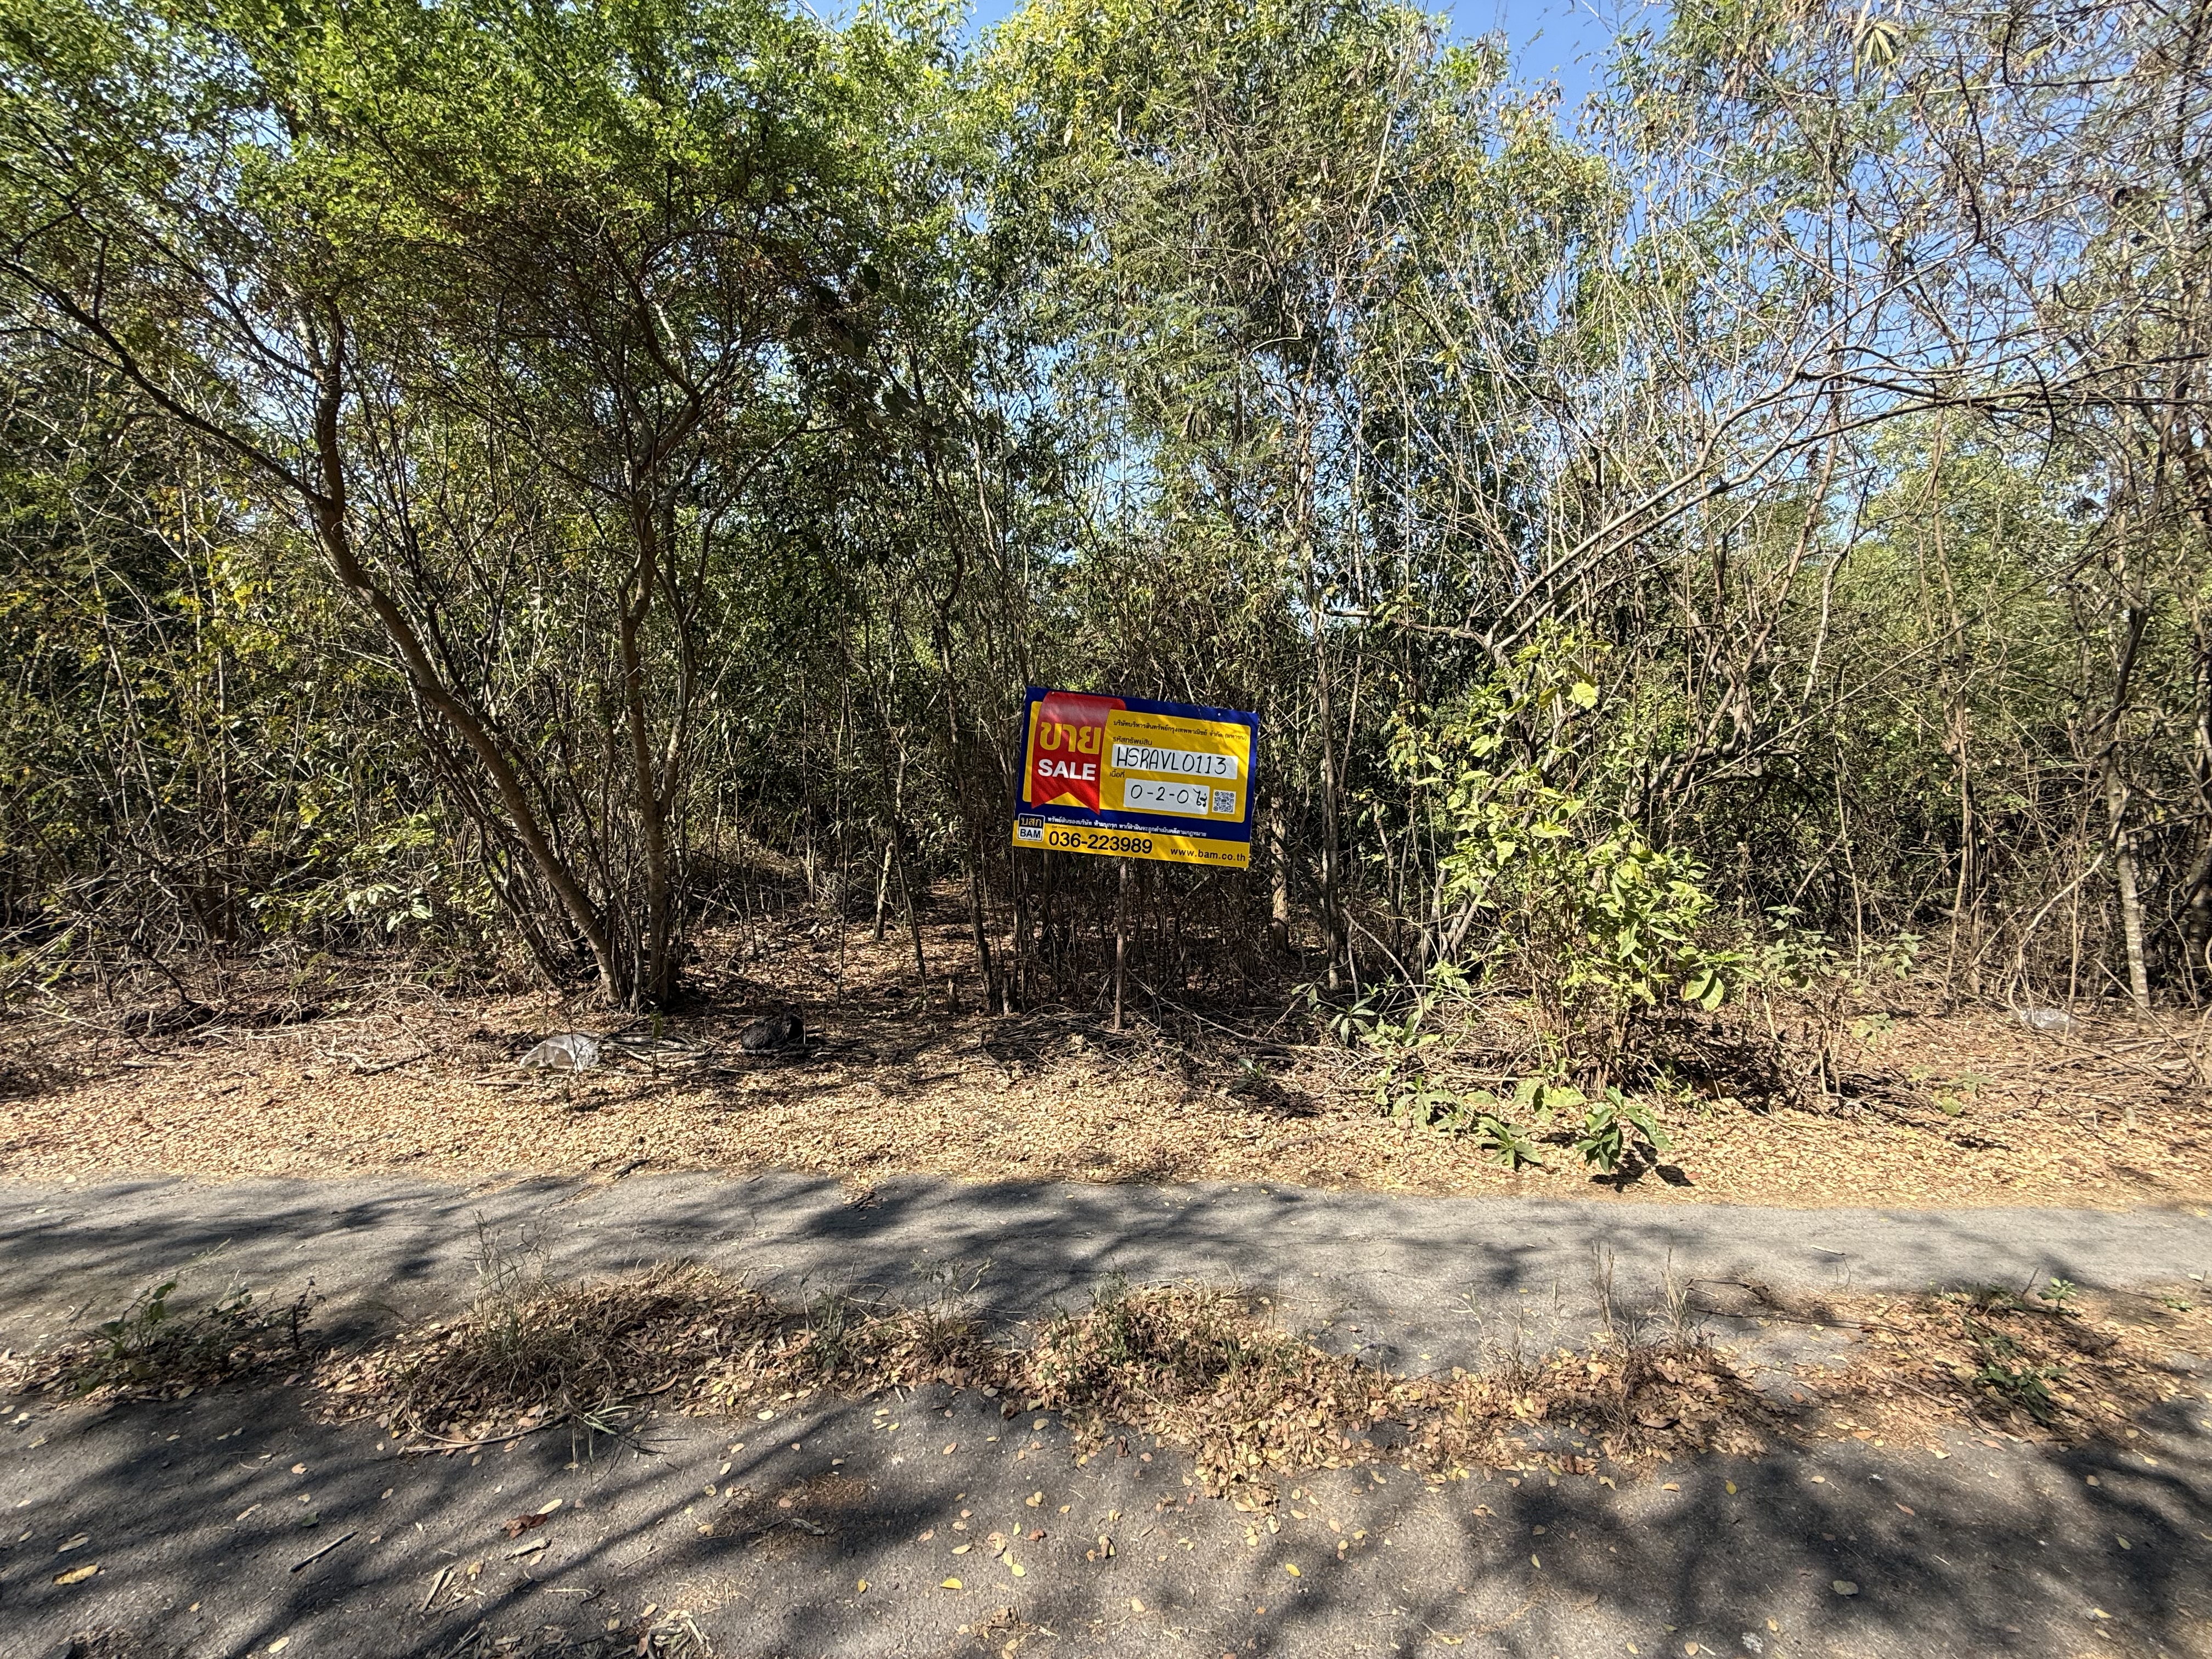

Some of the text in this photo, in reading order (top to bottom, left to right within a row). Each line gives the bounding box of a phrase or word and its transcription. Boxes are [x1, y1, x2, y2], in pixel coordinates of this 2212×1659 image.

[1040, 721, 1102, 754] ขาย
[1038, 759, 1096, 781] SALE
[1020, 817, 1042, 827] บสก
[1020, 828, 1041, 839] BAM
[1049, 831, 1153, 854] 036-223989
[1170, 848, 1246, 862] www.bam.co.th
